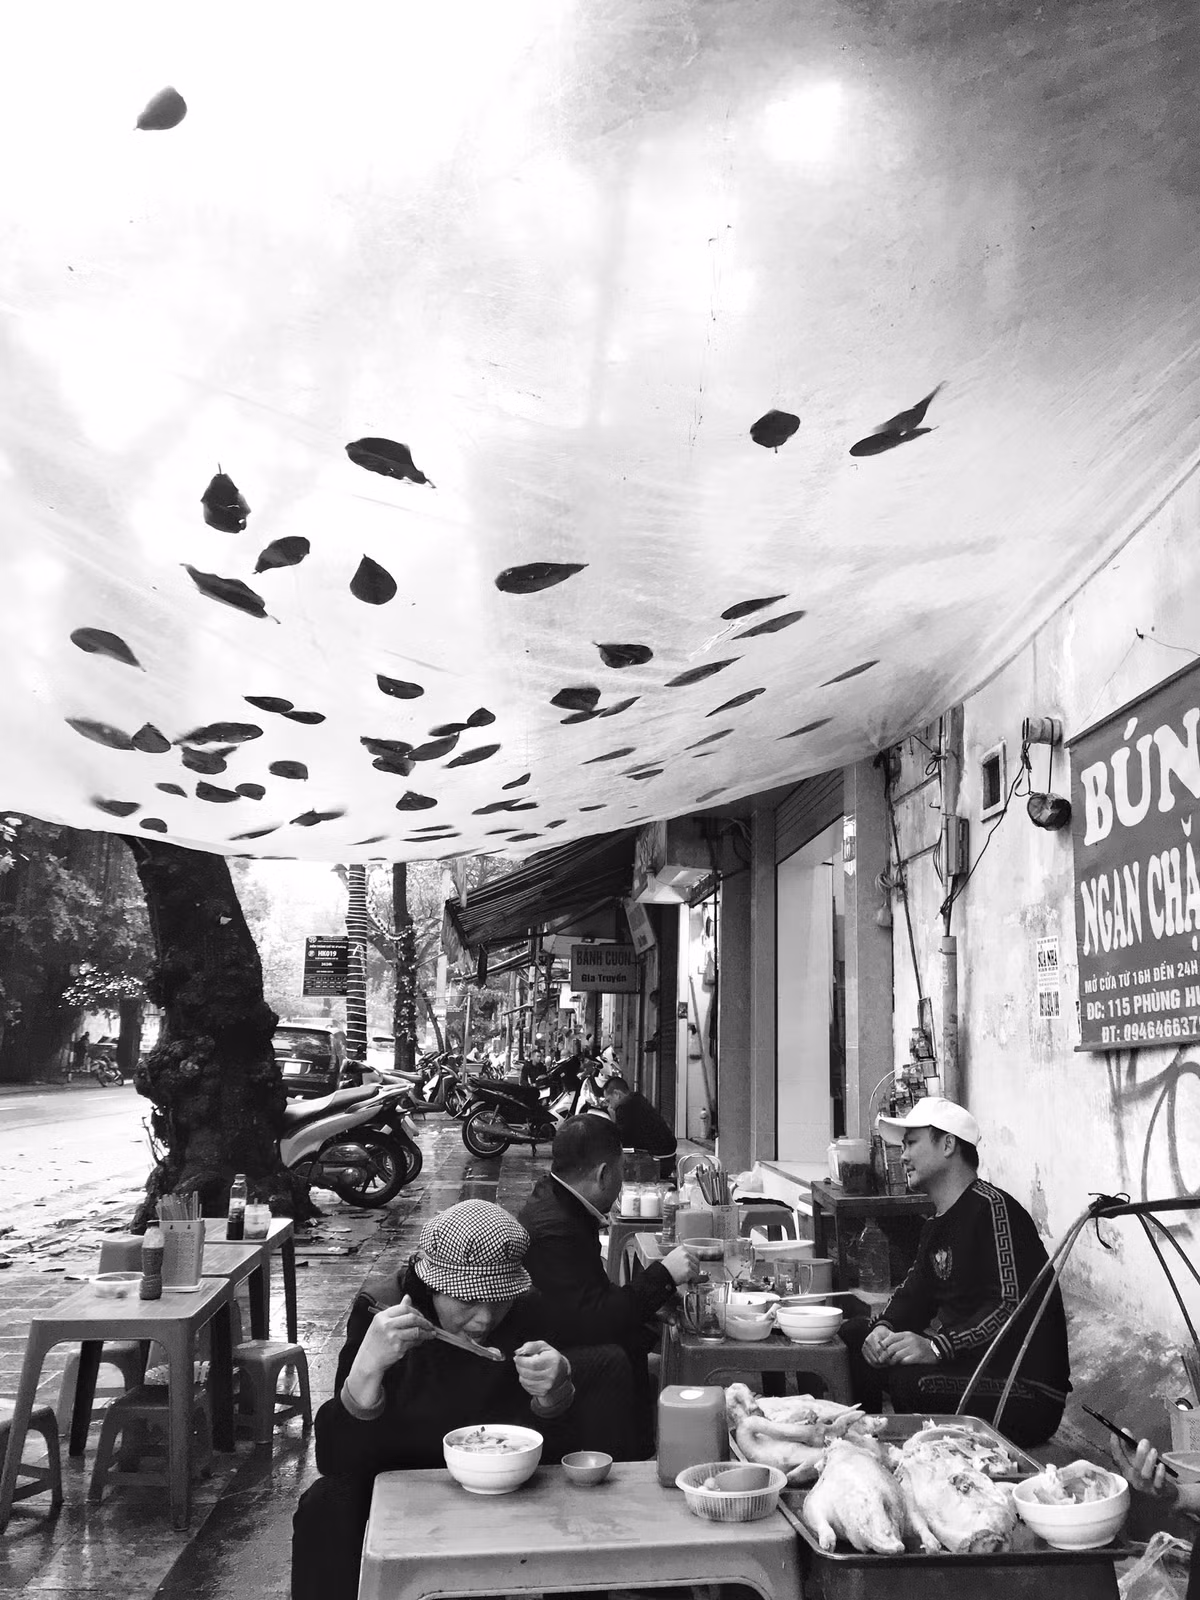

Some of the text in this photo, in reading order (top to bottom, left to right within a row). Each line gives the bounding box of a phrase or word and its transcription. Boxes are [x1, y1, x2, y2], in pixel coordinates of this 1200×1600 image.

[1081, 707, 1200, 846] BÚN
[1081, 861, 1143, 957] NGAN
[581, 973, 596, 983] Gia
[1084, 959, 1198, 994] MỞ CỬA TỪ 16H ĐẾN 24H
[1086, 1001, 1105, 1021] ĐC:
[1107, 997, 1131, 1017] 115
[1133, 988, 1181, 1015] PHÙNG
[1101, 1015, 1200, 1044] ĐT: 094646637
